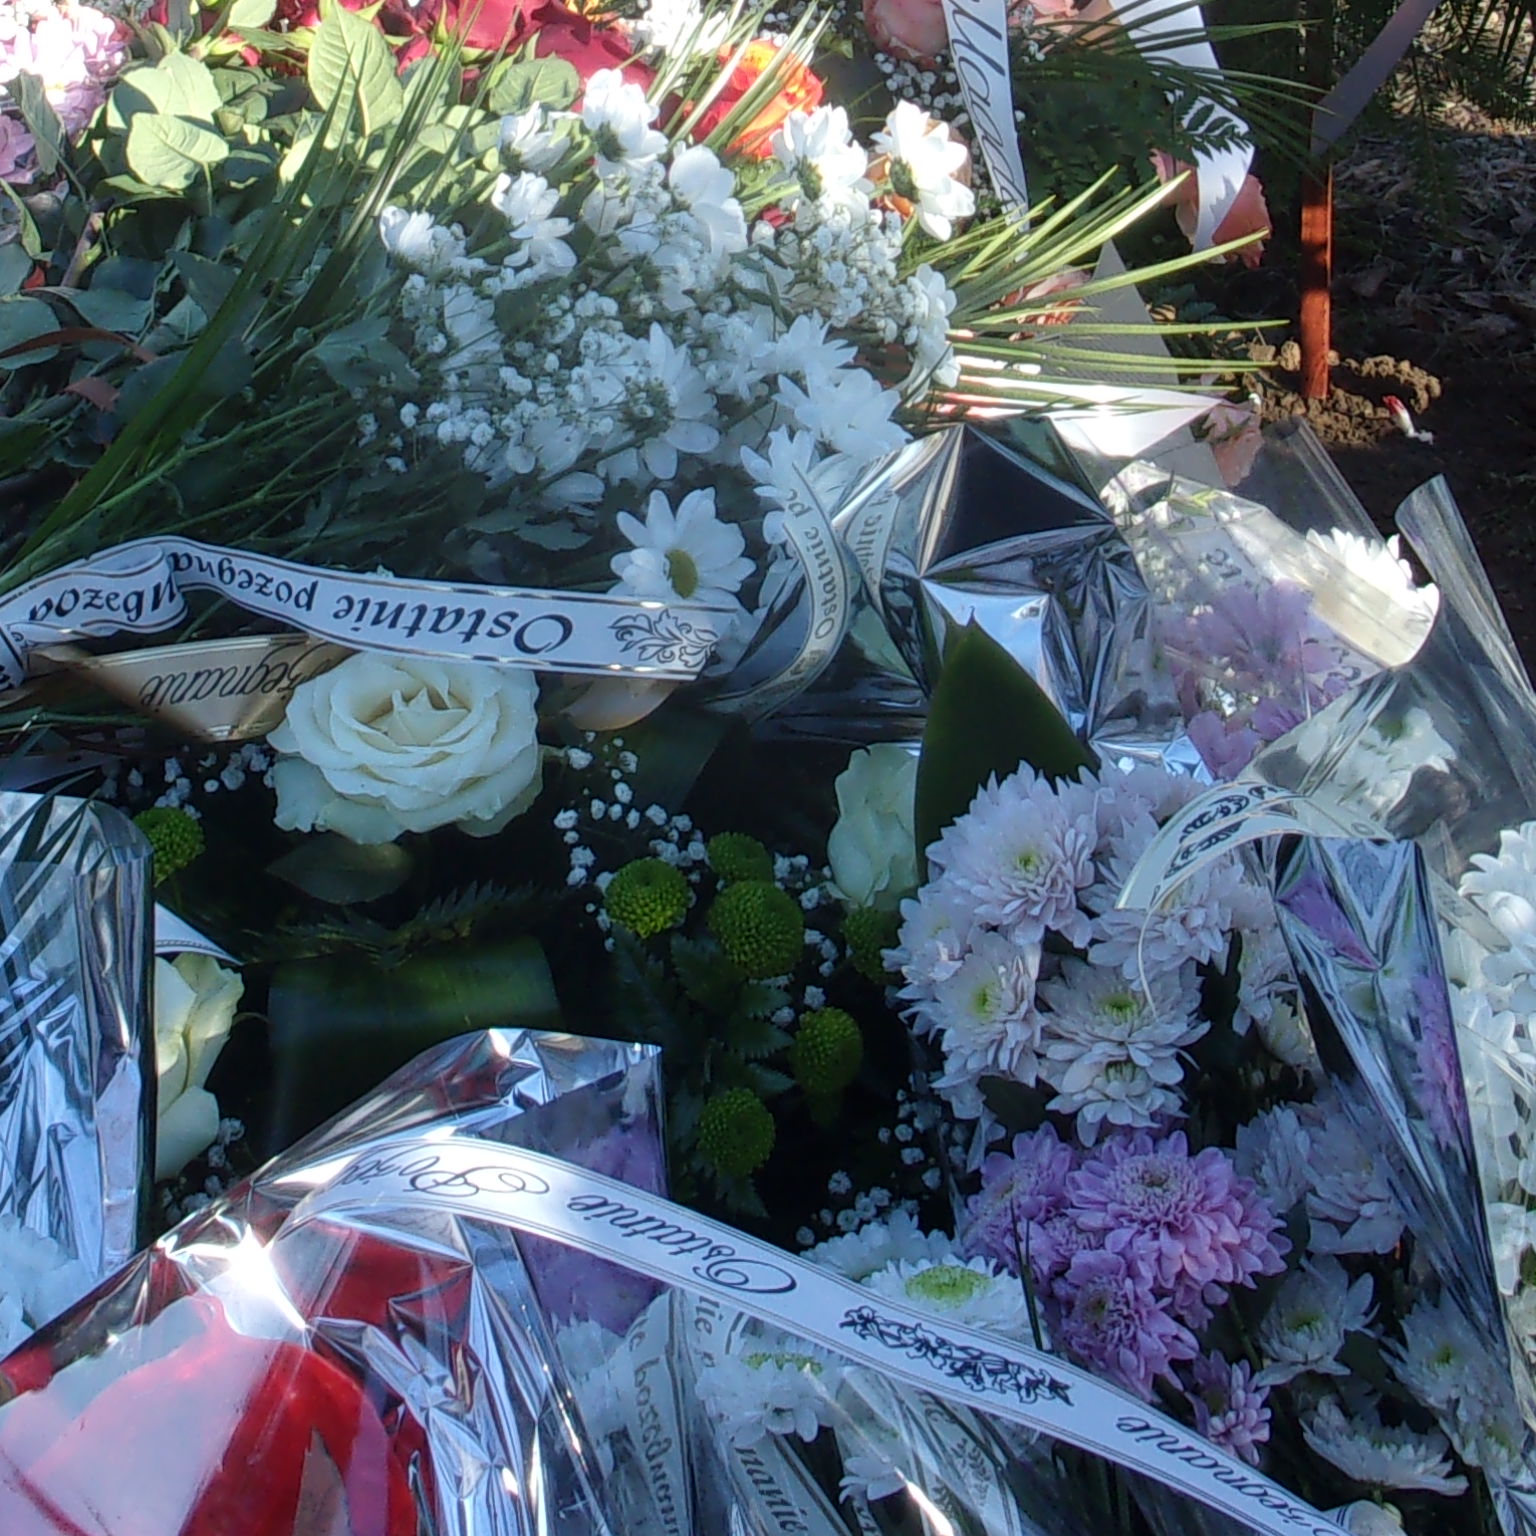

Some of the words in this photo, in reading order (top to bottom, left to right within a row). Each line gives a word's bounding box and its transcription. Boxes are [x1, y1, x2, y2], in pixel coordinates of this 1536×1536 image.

[332, 593, 573, 655] Ostatnie
[138, 640, 332, 715] żegnanie
[567, 1193, 797, 1293] Ostatnie
[1116, 1415, 1316, 1529] żegnanie
